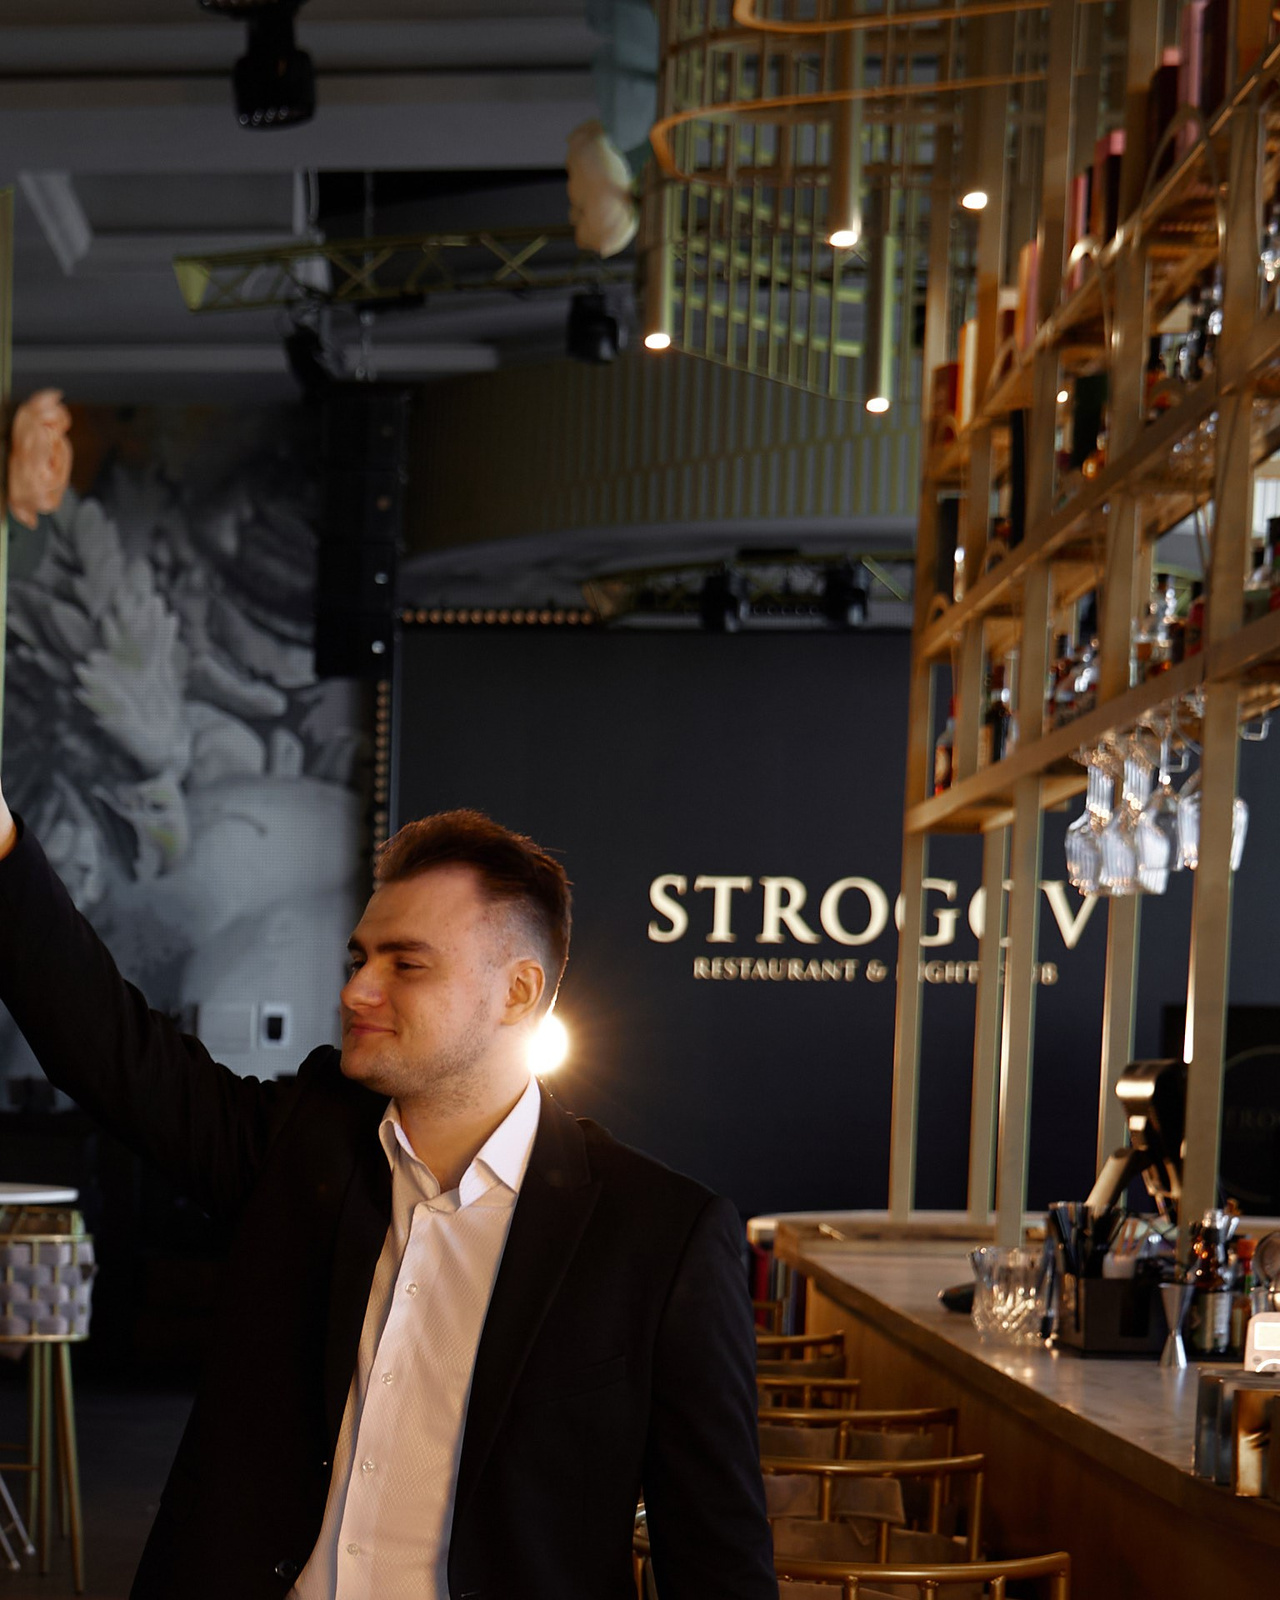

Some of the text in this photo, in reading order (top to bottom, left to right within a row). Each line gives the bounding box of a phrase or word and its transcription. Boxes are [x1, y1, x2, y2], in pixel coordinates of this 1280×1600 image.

[693, 956, 859, 982] RESTAURANT
[865, 958, 887, 983] &
[896, 960, 983, 985] IGHT
